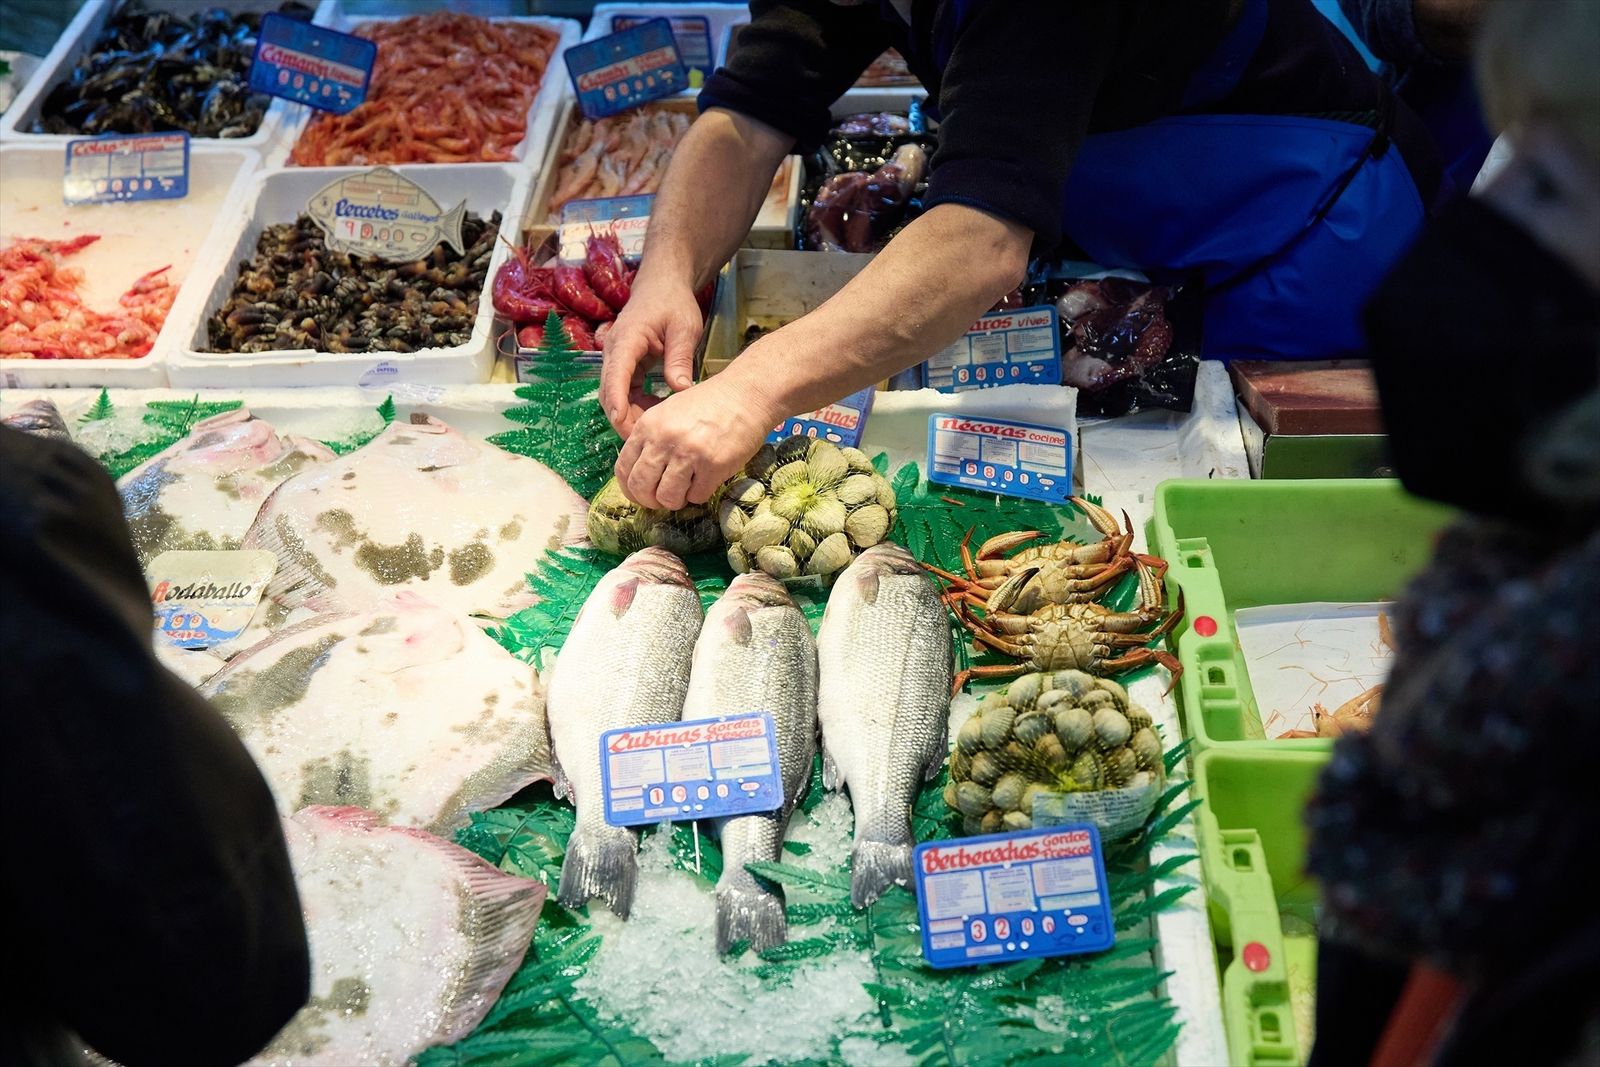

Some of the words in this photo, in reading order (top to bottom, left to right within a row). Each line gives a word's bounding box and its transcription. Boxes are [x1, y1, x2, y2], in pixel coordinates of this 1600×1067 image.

[335, 198, 399, 220] Percebes
[969, 316, 1014, 332] aros
[152, 581, 252, 604] Rodaballo
[924, 840, 1041, 874] Berberechos
